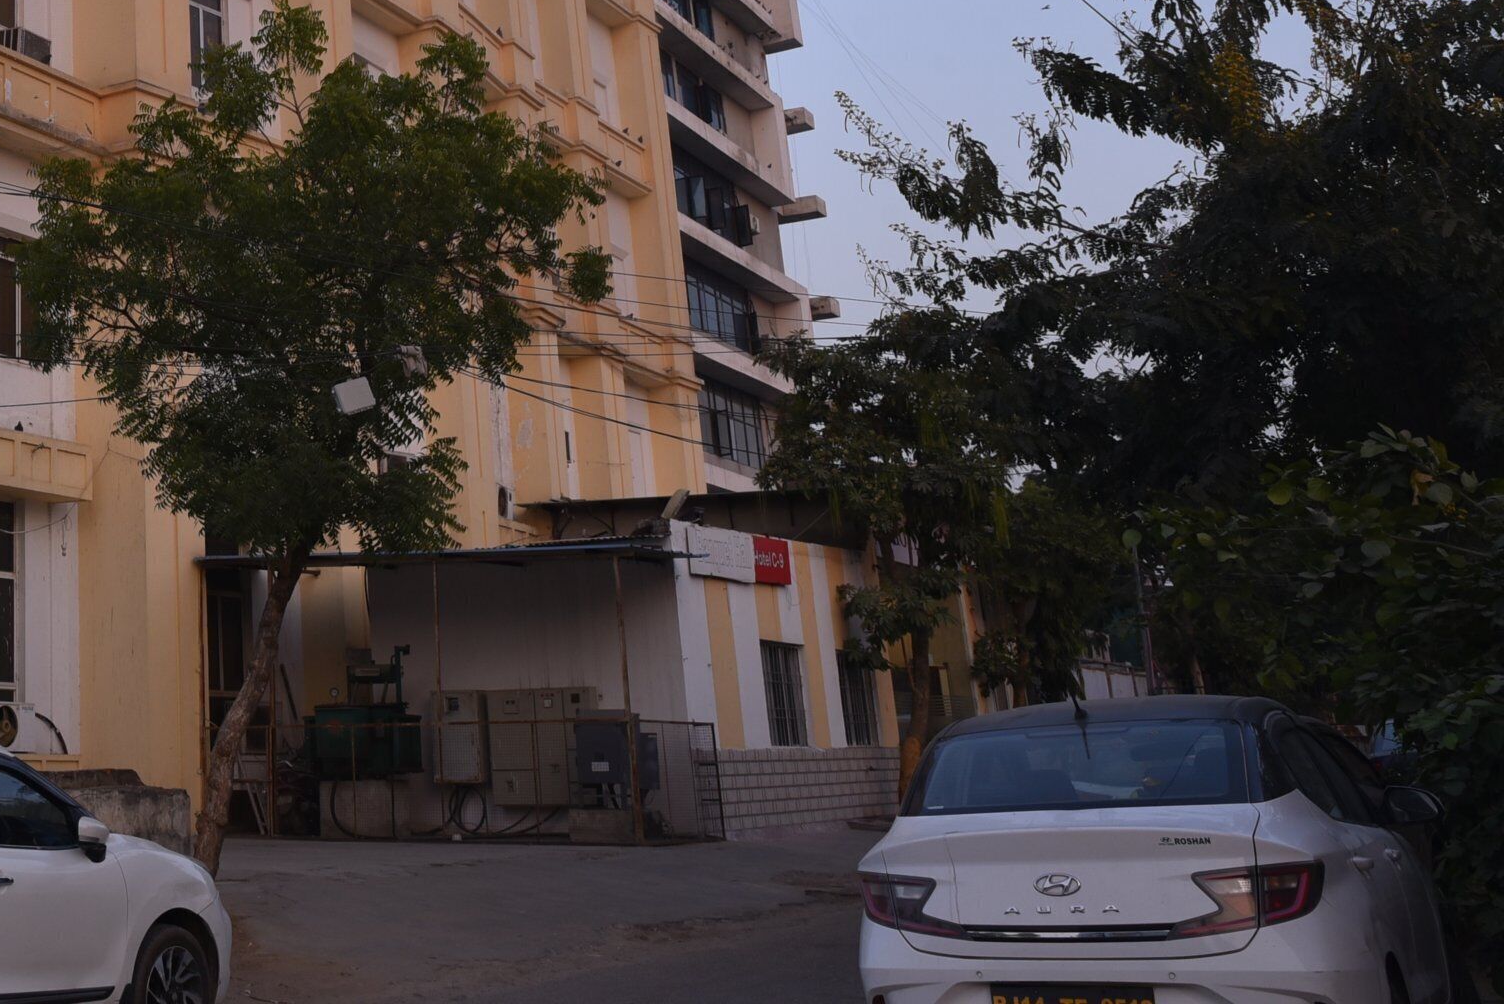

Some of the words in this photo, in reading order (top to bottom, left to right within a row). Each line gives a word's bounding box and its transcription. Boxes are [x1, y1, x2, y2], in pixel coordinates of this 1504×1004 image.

[754, 549, 771, 568] Hotel
[772, 552, 784, 569] C-9
[1174, 837, 1211, 845] ROSHAN
[1004, 904, 1120, 915] AURA
